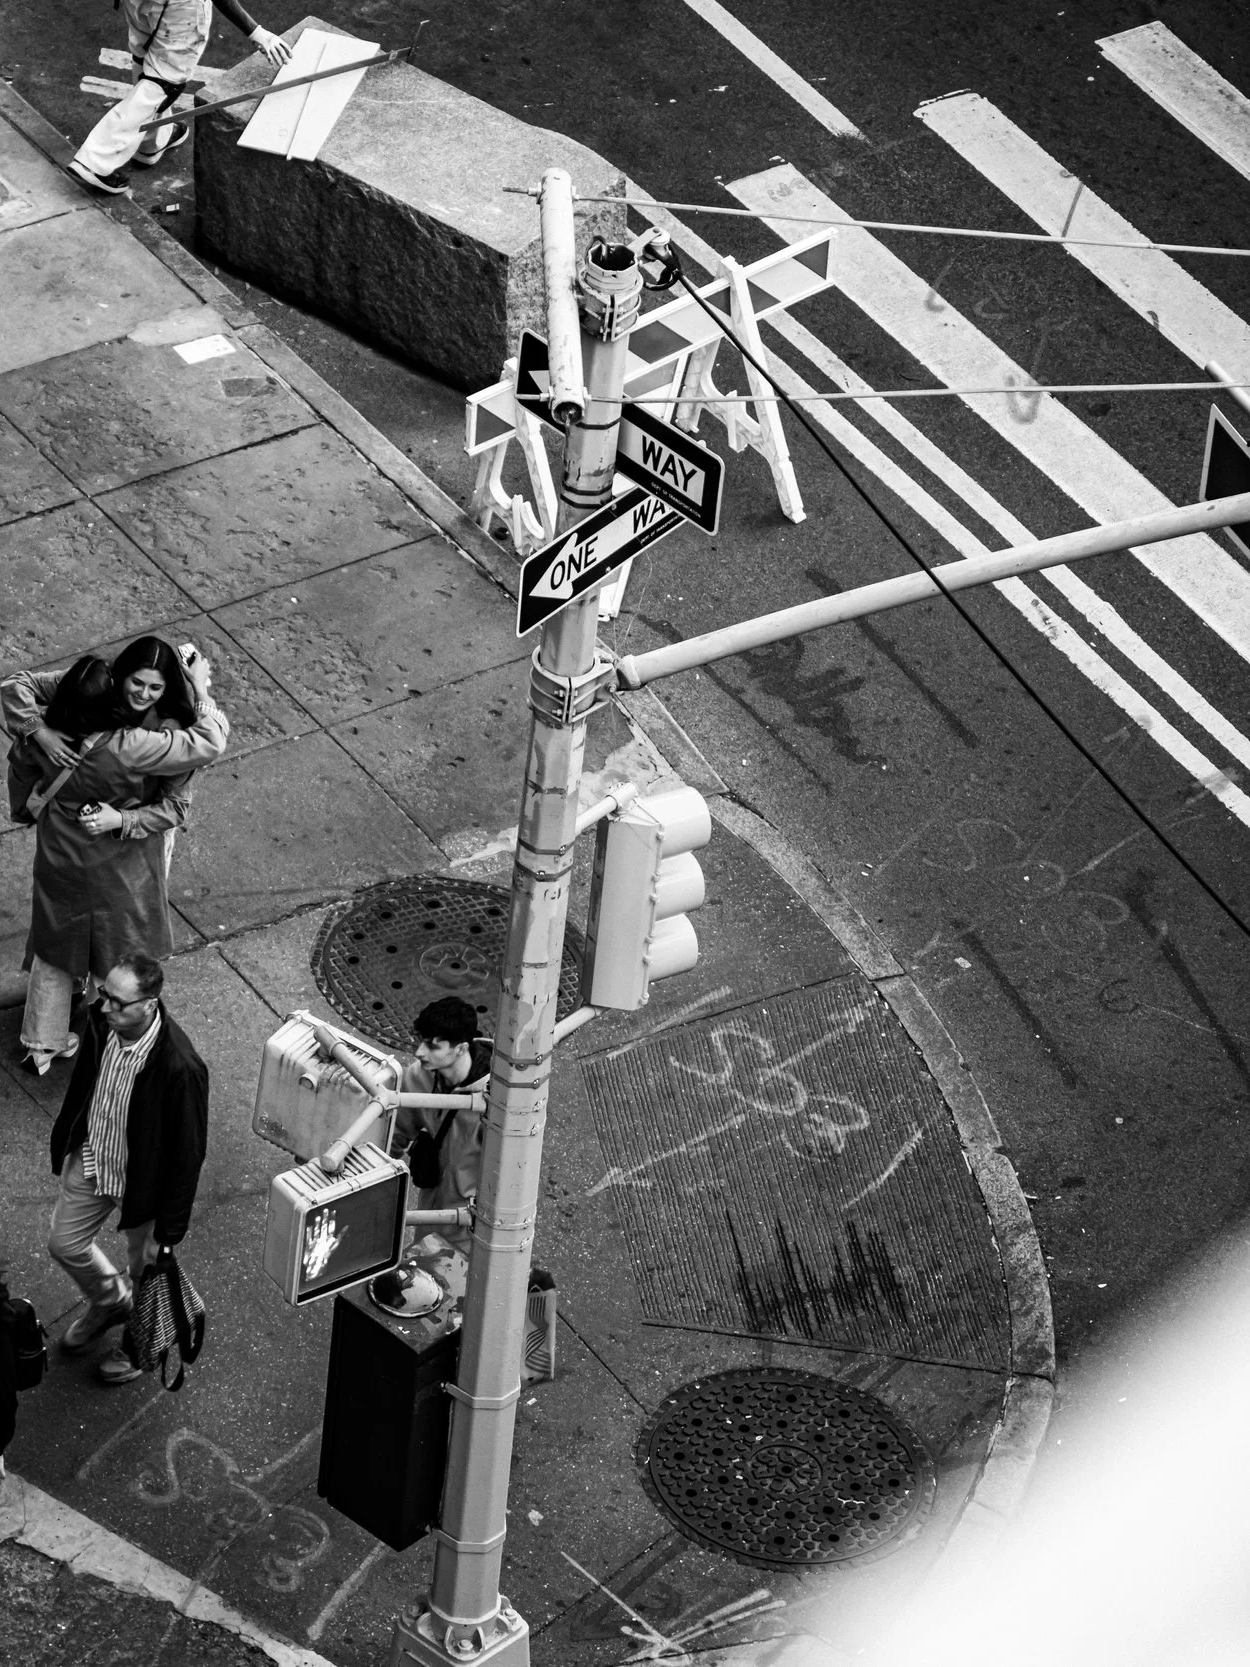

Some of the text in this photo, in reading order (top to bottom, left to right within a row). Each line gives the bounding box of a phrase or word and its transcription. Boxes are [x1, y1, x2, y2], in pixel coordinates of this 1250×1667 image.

[642, 434, 698, 492] WAY
[550, 535, 599, 591] ONE
[633, 498, 672, 535] WA
